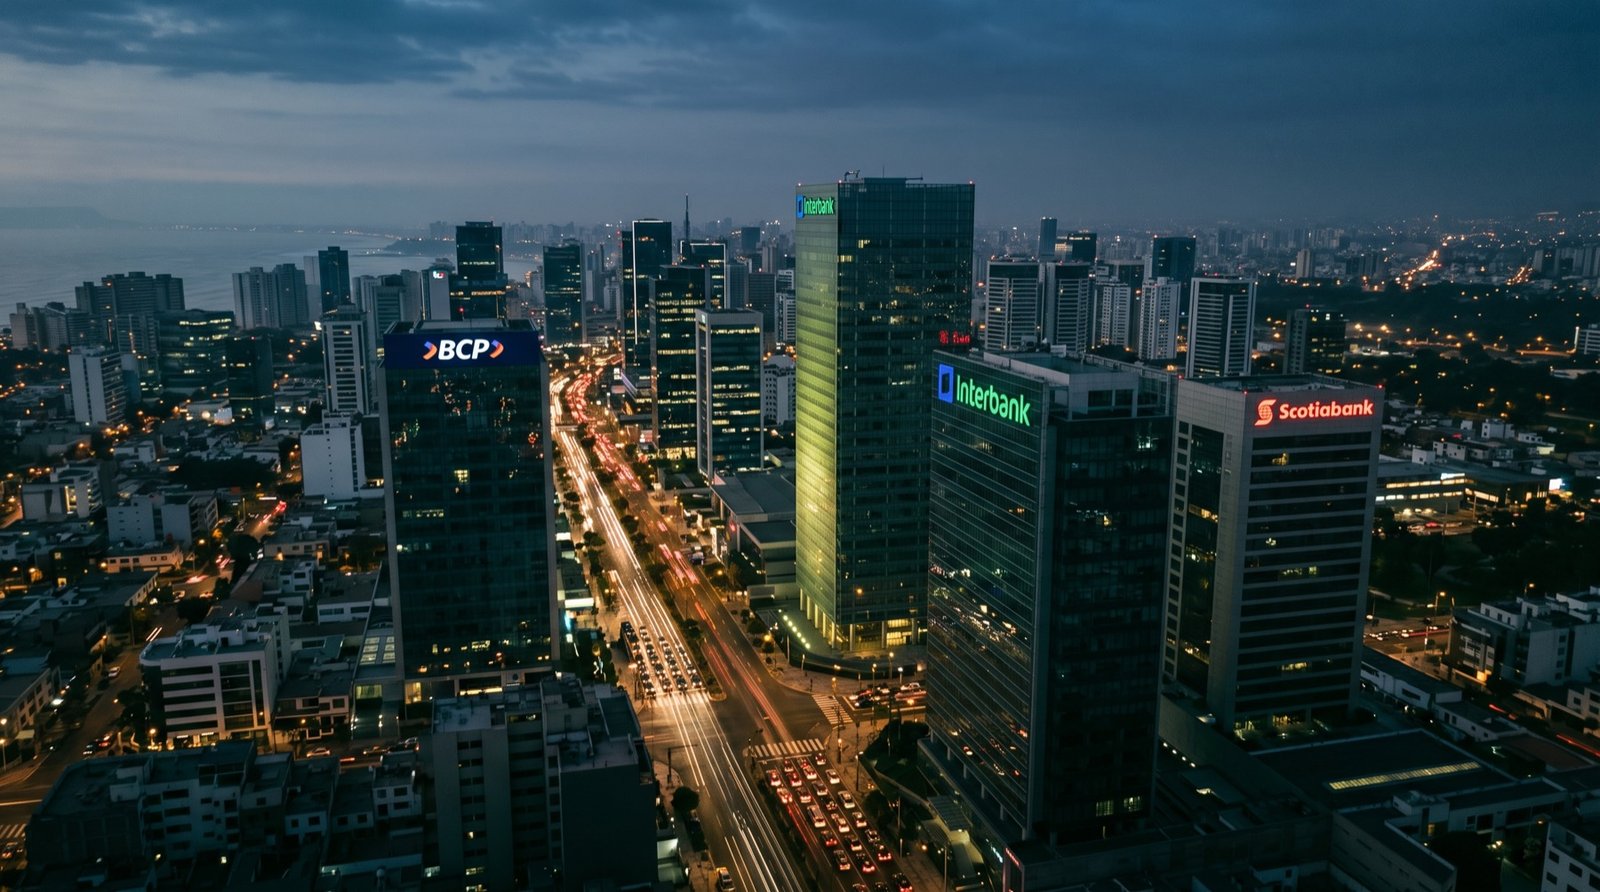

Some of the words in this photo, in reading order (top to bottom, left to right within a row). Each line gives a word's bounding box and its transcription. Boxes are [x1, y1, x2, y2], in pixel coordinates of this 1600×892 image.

[803, 196, 834, 215] Interbank
[437, 338, 490, 361] BCP
[956, 374, 1031, 427] Interbank
[1279, 399, 1374, 420] Scotiabank
